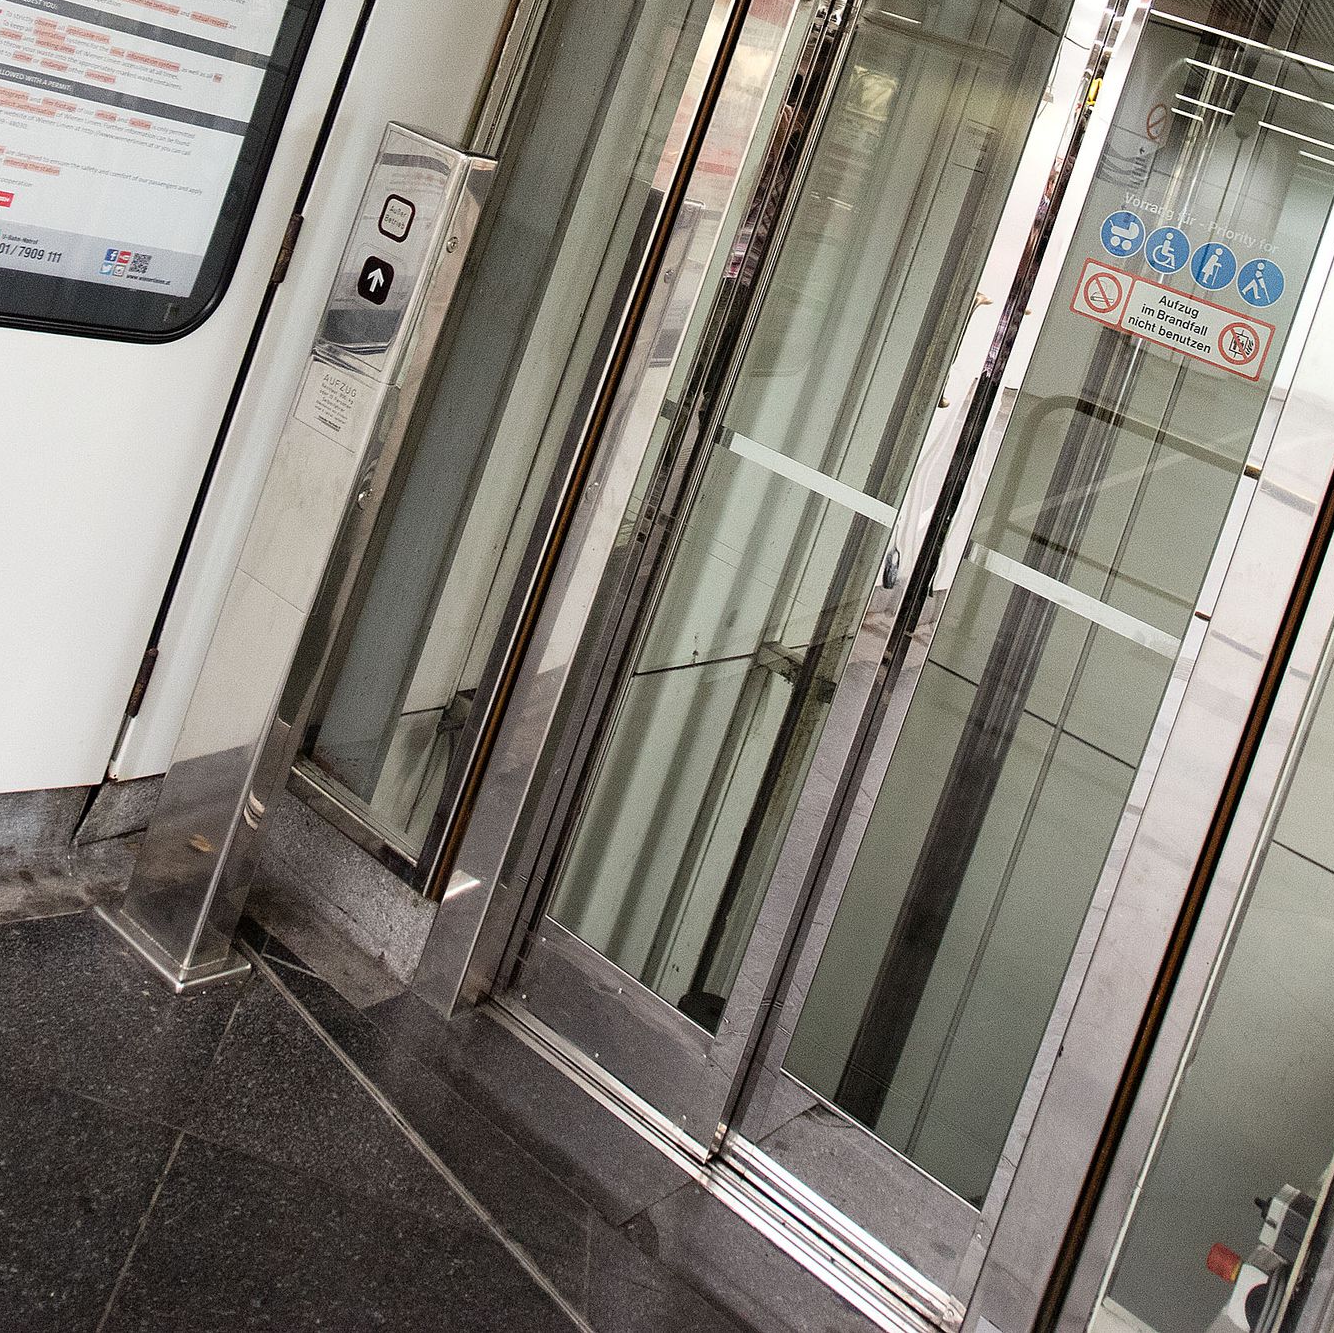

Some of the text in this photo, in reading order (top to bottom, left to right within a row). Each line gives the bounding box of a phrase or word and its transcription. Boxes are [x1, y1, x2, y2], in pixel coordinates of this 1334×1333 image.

[1125, 192, 1175, 221] Vorrang
[1208, 221, 1256, 248] Priority
[1259, 239, 1279, 254] for
[17, 246, 45, 260] 7909
[45, 250, 62, 263] 111
[1141, 304, 1208, 337] im Brandfall
[1159, 295, 1200, 319] Aufzug
[1128, 316, 1211, 354] nicht benutzen
[323, 374, 357, 399] AUFZUG
